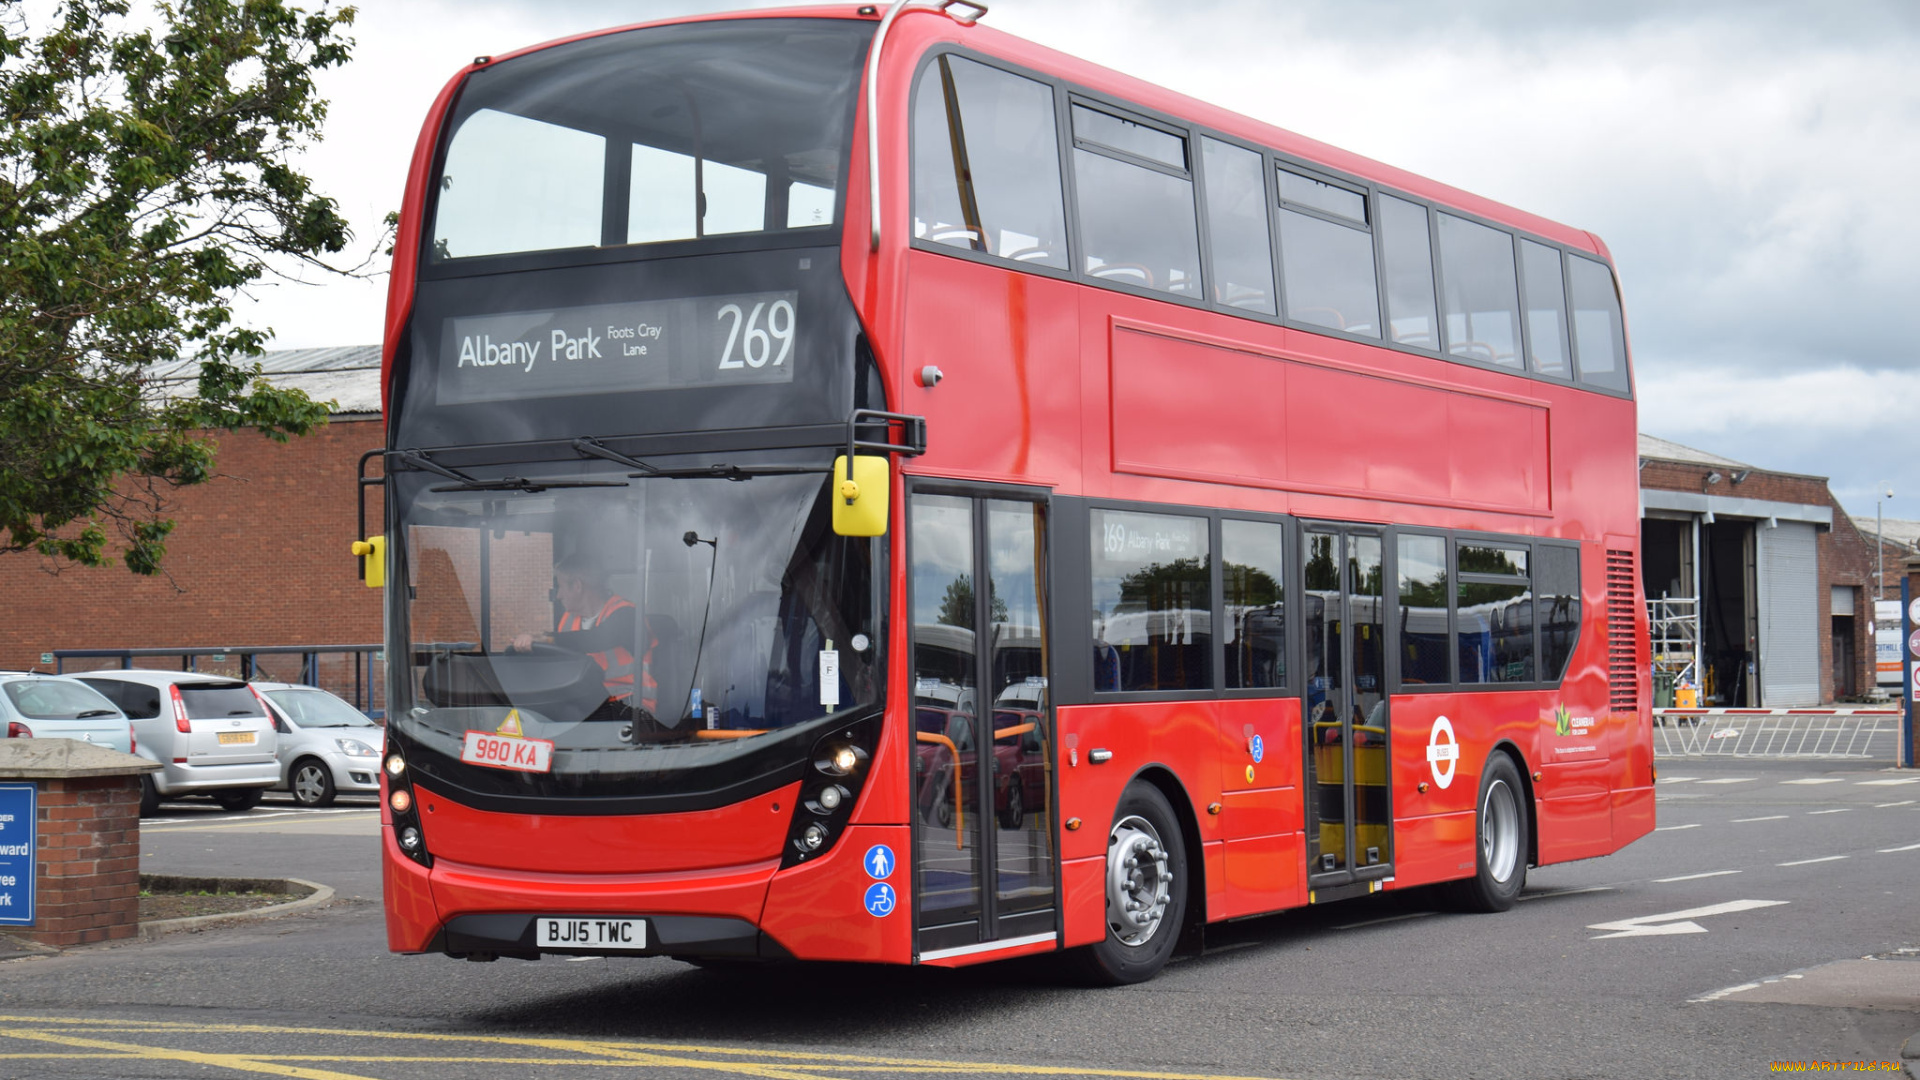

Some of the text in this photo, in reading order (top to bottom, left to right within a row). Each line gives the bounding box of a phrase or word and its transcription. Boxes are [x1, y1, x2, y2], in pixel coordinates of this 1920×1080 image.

[607, 323, 663, 340] Foots Cray
[717, 300, 796, 370] 269
[457, 328, 602, 373] Albany Park
[623, 342, 647, 357] Lane
[826, 665, 833, 675] F
[475, 738, 536, 766] 980 KA
[548, 921, 632, 943] BJ15 TWC
